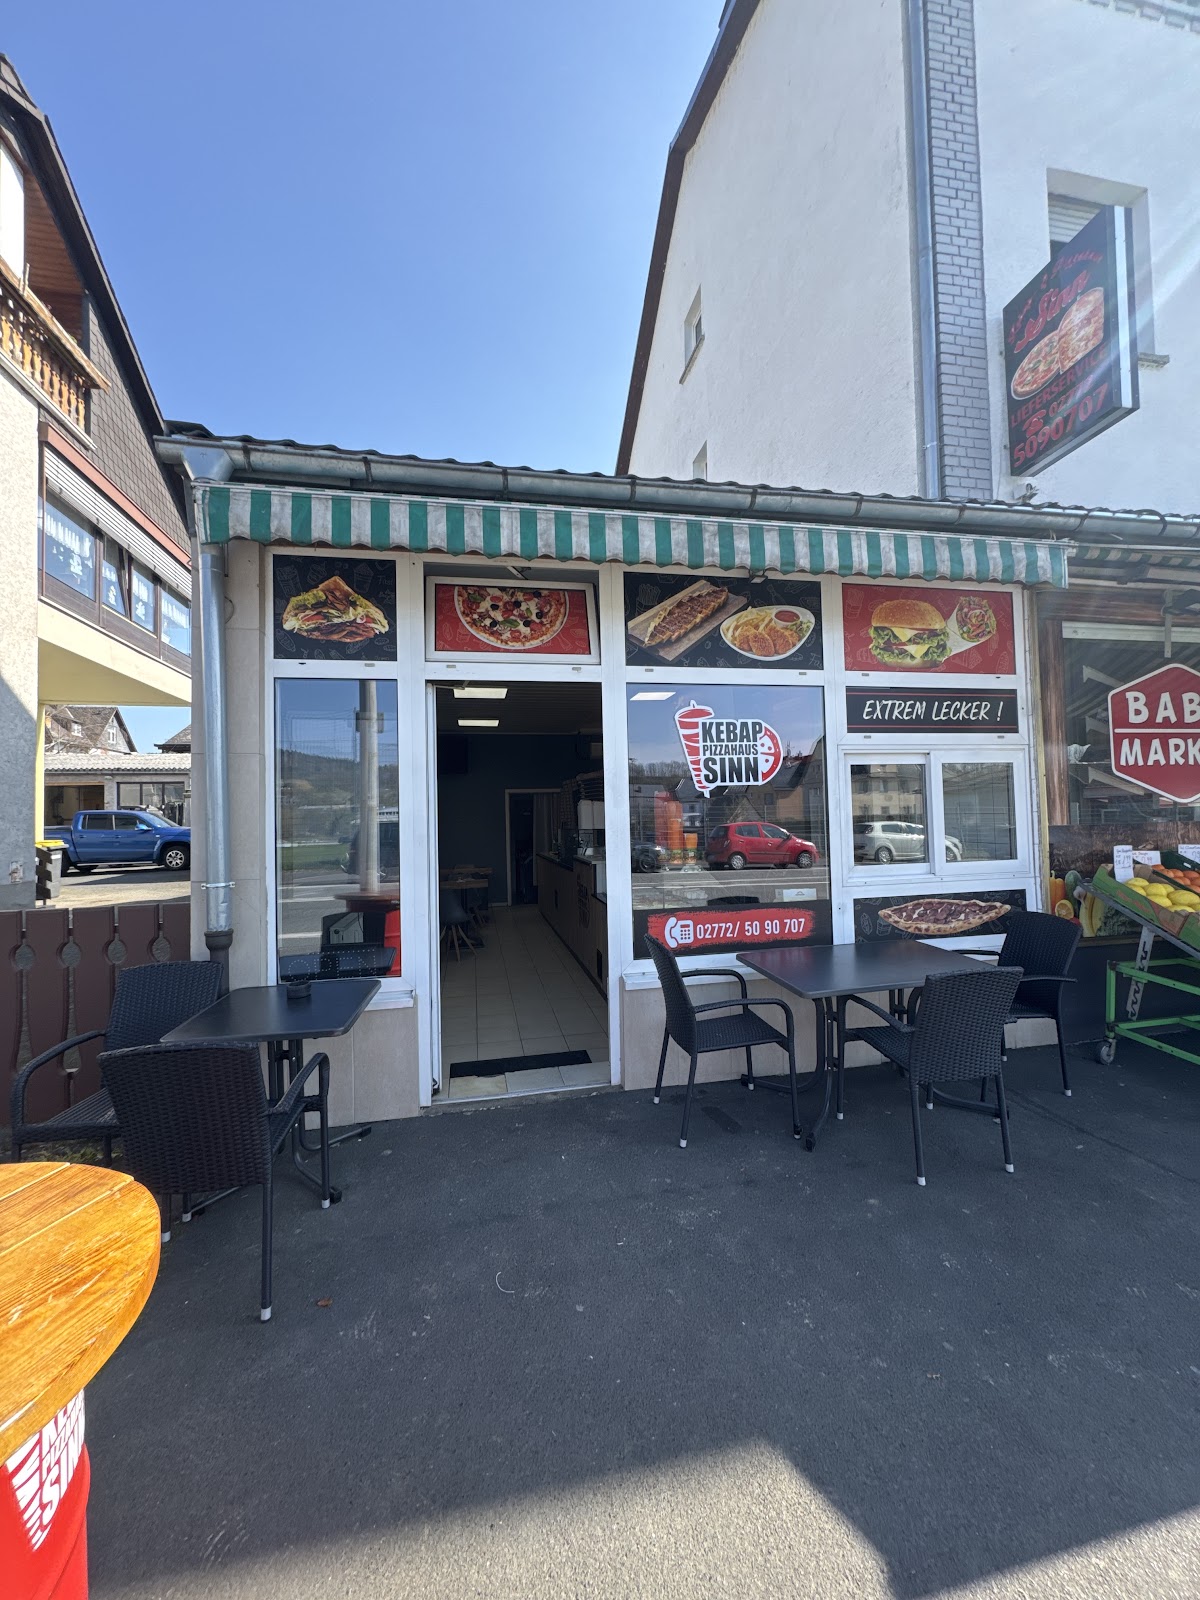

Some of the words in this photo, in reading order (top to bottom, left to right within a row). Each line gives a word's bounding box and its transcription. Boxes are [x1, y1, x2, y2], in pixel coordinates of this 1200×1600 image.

[1011, 343, 1107, 428] LIEFERSERVICE
[1014, 382, 1109, 468] 5090707
[863, 700, 926, 721] EXTREM
[932, 701, 991, 721] LECKER
[1125, 691, 1200, 724] BAB
[702, 721, 763, 744] KEBAP
[702, 744, 759, 757] PIZZAHAUS
[1120, 737, 1200, 767] MARK
[703, 757, 759, 784] SINN
[696, 920, 740, 940] 02772/
[745, 921, 760, 936] 50
[764, 919, 780, 935] 90
[784, 918, 805, 934] 707
[288, 955, 377, 981] OPEN
